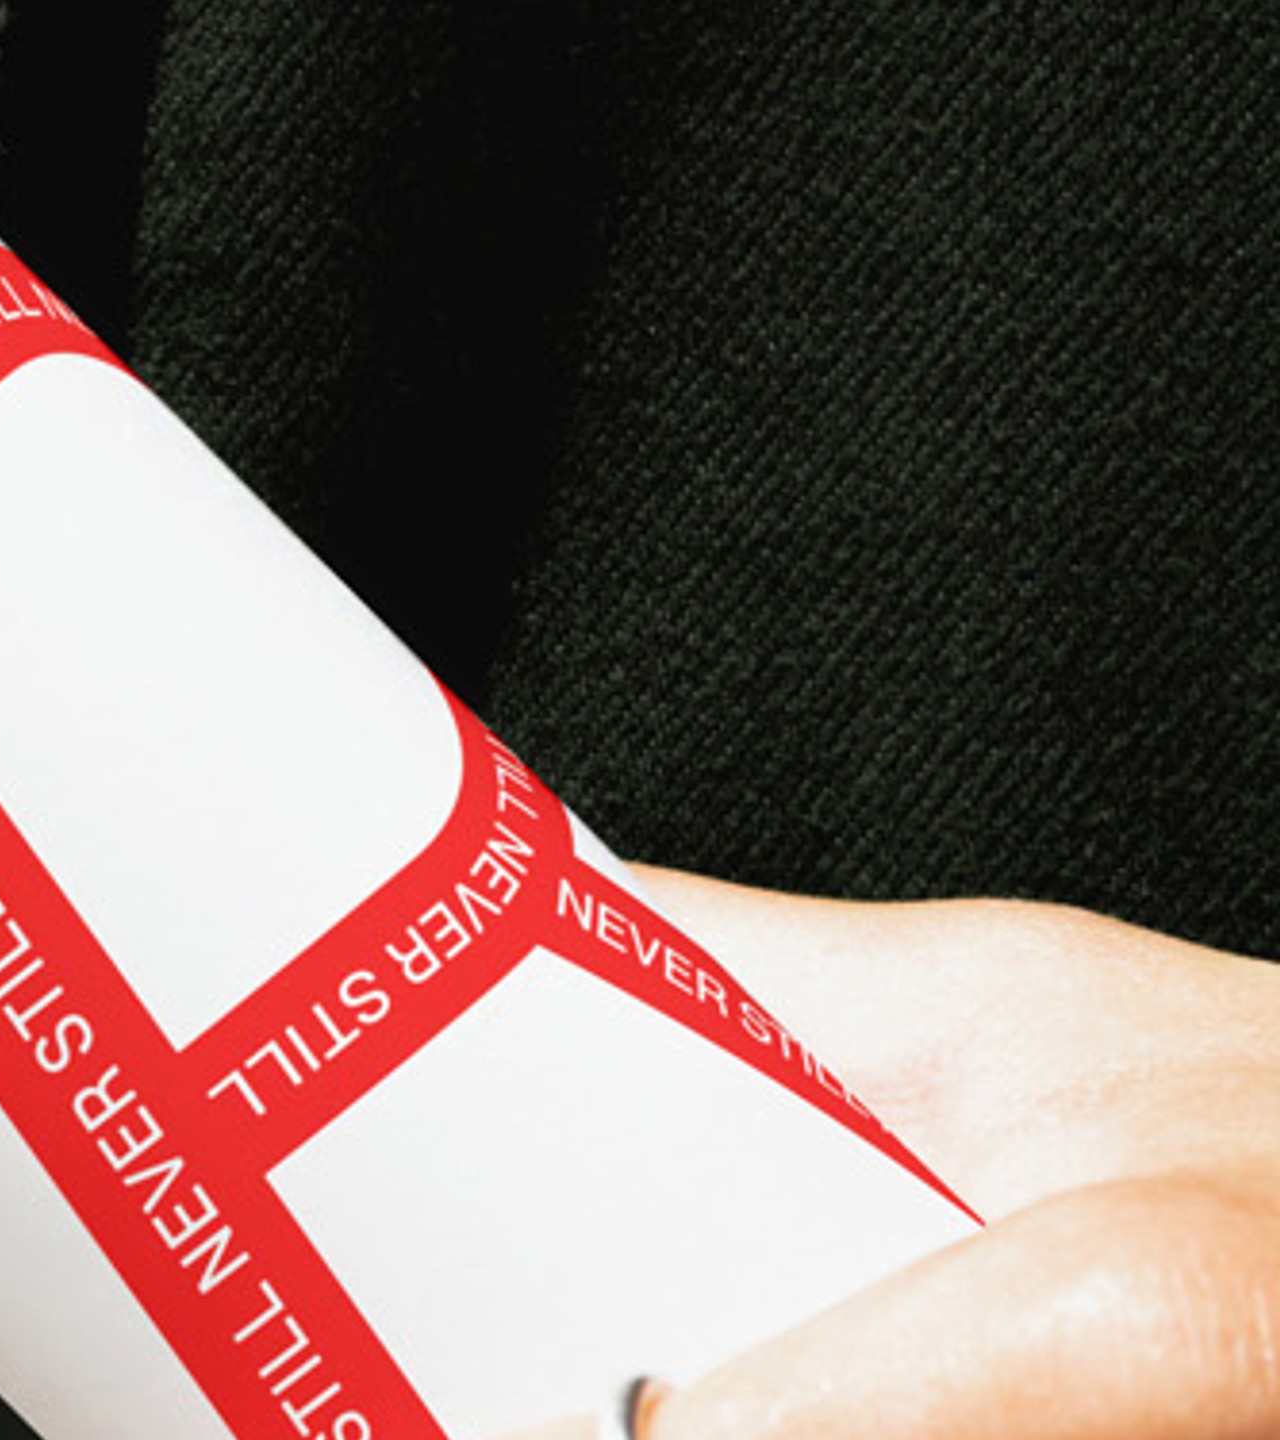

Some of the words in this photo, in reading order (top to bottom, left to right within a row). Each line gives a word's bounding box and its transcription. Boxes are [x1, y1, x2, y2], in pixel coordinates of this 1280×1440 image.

[385, 821, 535, 983] NEVER
[556, 877, 729, 1018] NEVER
[207, 970, 390, 1115] STILL
[72, 1064, 250, 1295] NEVER
